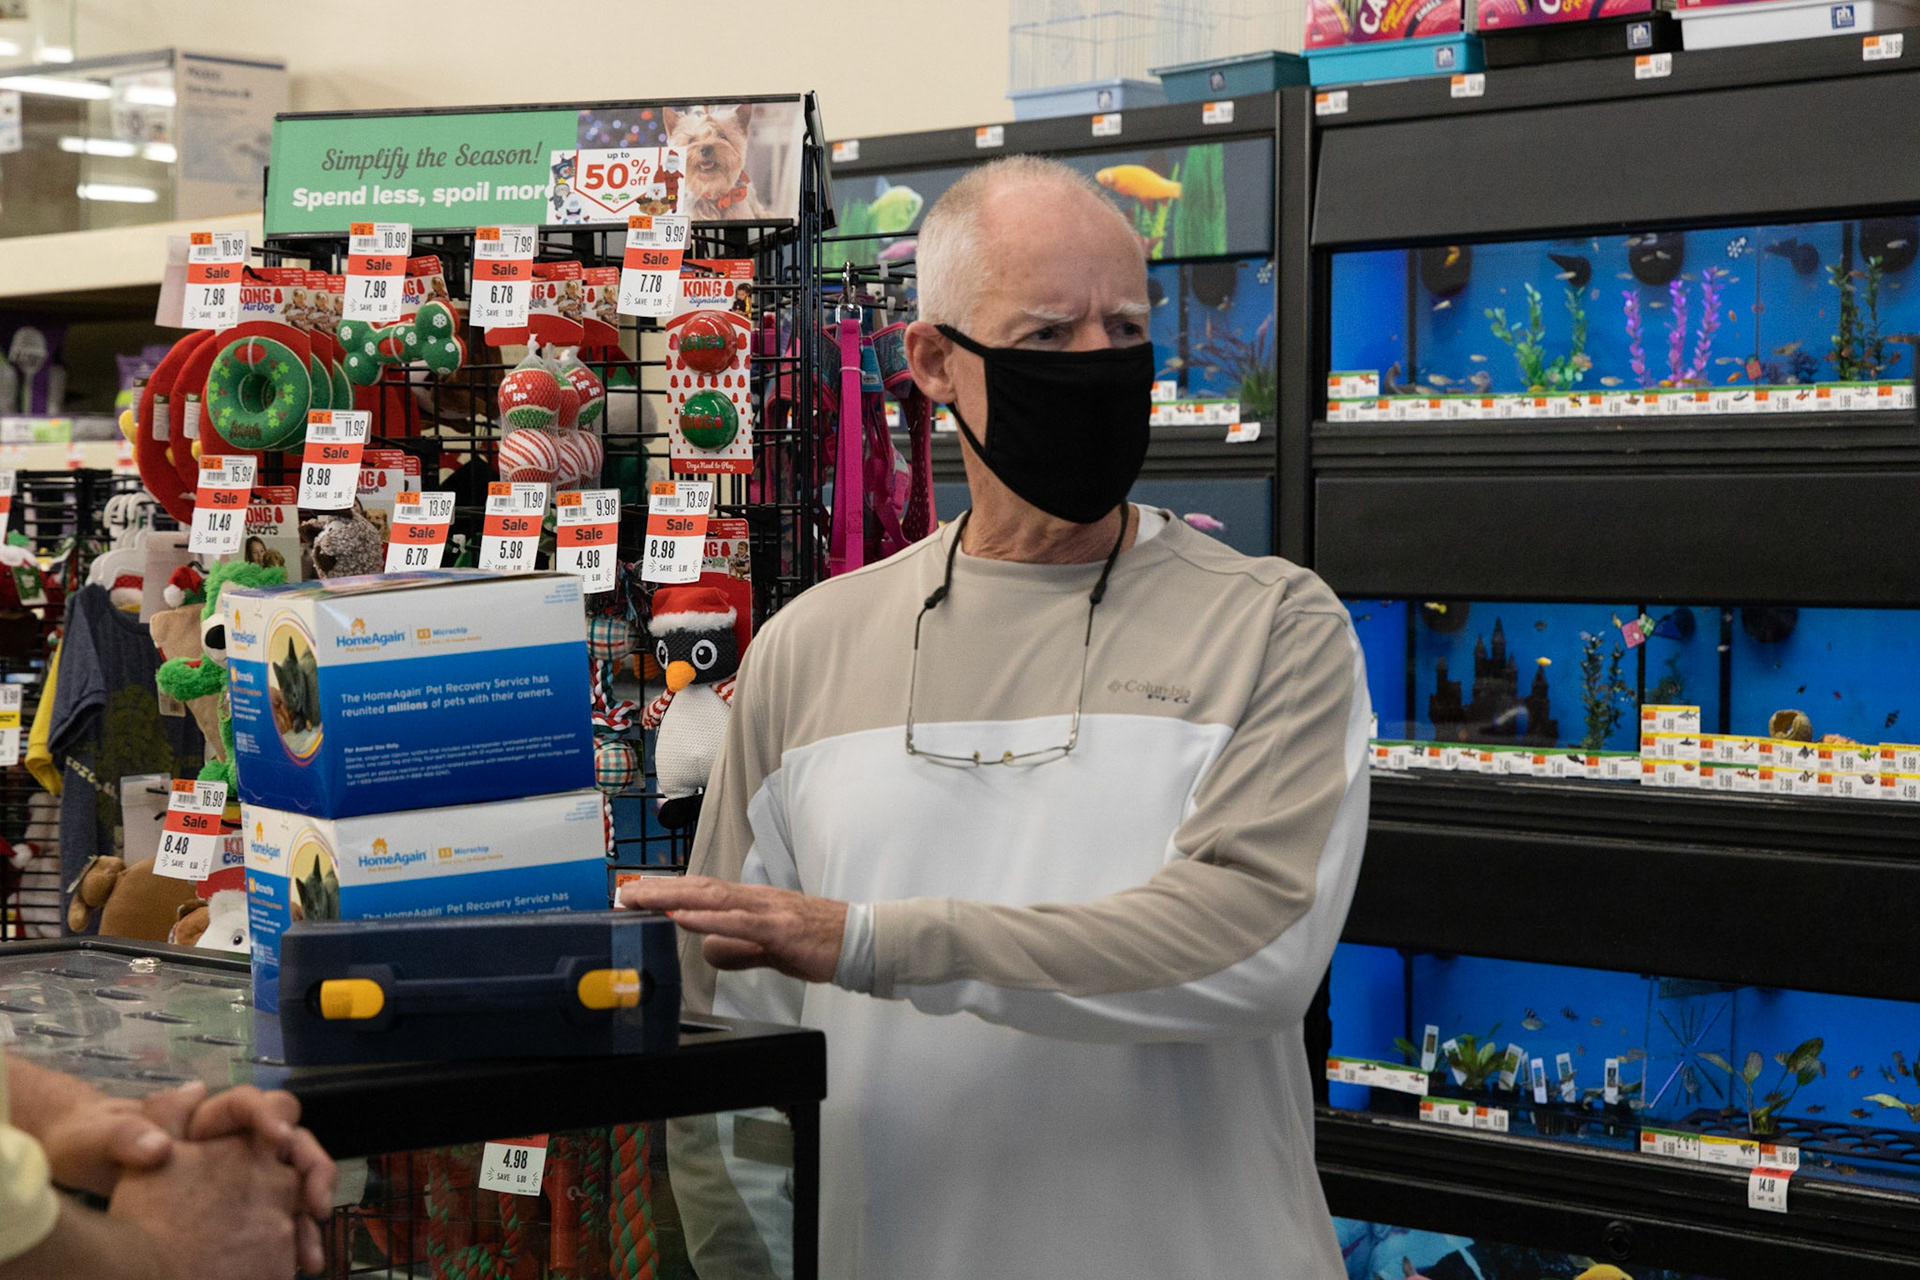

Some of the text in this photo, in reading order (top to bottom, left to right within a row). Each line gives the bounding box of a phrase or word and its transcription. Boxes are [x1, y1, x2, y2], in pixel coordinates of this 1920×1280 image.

[322, 141, 543, 180] Simplify the Season!
[607, 152, 619, 160] up
[630, 176, 648, 186] off
[292, 185, 367, 212] Spend
[373, 185, 425, 207] less,
[432, 181, 490, 207] spoil
[384, 232, 407, 249] 10.98
[665, 226, 685, 242] 9.98
[222, 239, 244, 257] 10.98
[514, 236, 532, 253] 7.98
[366, 259, 392, 270] Sale
[642, 252, 669, 265] Sale
[205, 266, 230, 279] Sale
[491, 263, 518, 275] Sale
[364, 280, 387, 298] 7.98
[640, 274, 662, 293] 7.78
[683, 281, 721, 297] KONG
[204, 288, 225, 306] 7.98
[491, 285, 513, 304] 6.78
[634, 298, 647, 306] SAVE
[689, 294, 727, 308] Signature
[486, 309, 499, 317] SAVE
[345, 420, 366, 437] 11.98
[322, 447, 349, 459] Sale
[231, 466, 253, 482] 15.98
[306, 467, 331, 486] 8.98
[213, 492, 238, 504] Sale
[315, 491, 328, 499] SAVE
[523, 491, 544, 509] 11.98
[686, 491, 710, 508] 13.98
[245, 507, 272, 523] ONG
[429, 500, 452, 517] 13.98
[596, 498, 616, 517] 9.98
[208, 513, 232, 532] 11.48
[502, 518, 529, 531] Sale
[666, 518, 694, 531] Sale
[408, 526, 435, 539] Sale
[575, 527, 603, 541] Sale
[405, 547, 429, 566] 6.78
[499, 540, 523, 559] 5.98
[650, 539, 676, 559] 8.98
[576, 549, 600, 569] 4.98
[659, 564, 673, 572] SAVE
[336, 630, 406, 647] HomeAgain
[341, 674, 549, 704] The HomeAgain Pet Recovery Service has
[341, 688, 554, 717] reunited millions of pets with their owners.
[202, 789, 225, 807] 16.98
[182, 815, 208, 829] Sale
[164, 835, 190, 855] 8.48
[171, 859, 184, 868] SAVE
[358, 849, 427, 867] HomeAgain
[447, 903, 464, 914] Pet
[466, 898, 512, 911] Recovery
[514, 894, 550, 906] Service
[552, 892, 569, 902] has
[502, 1148, 528, 1170] 4.98
[497, 1172, 511, 1182] SAVE
